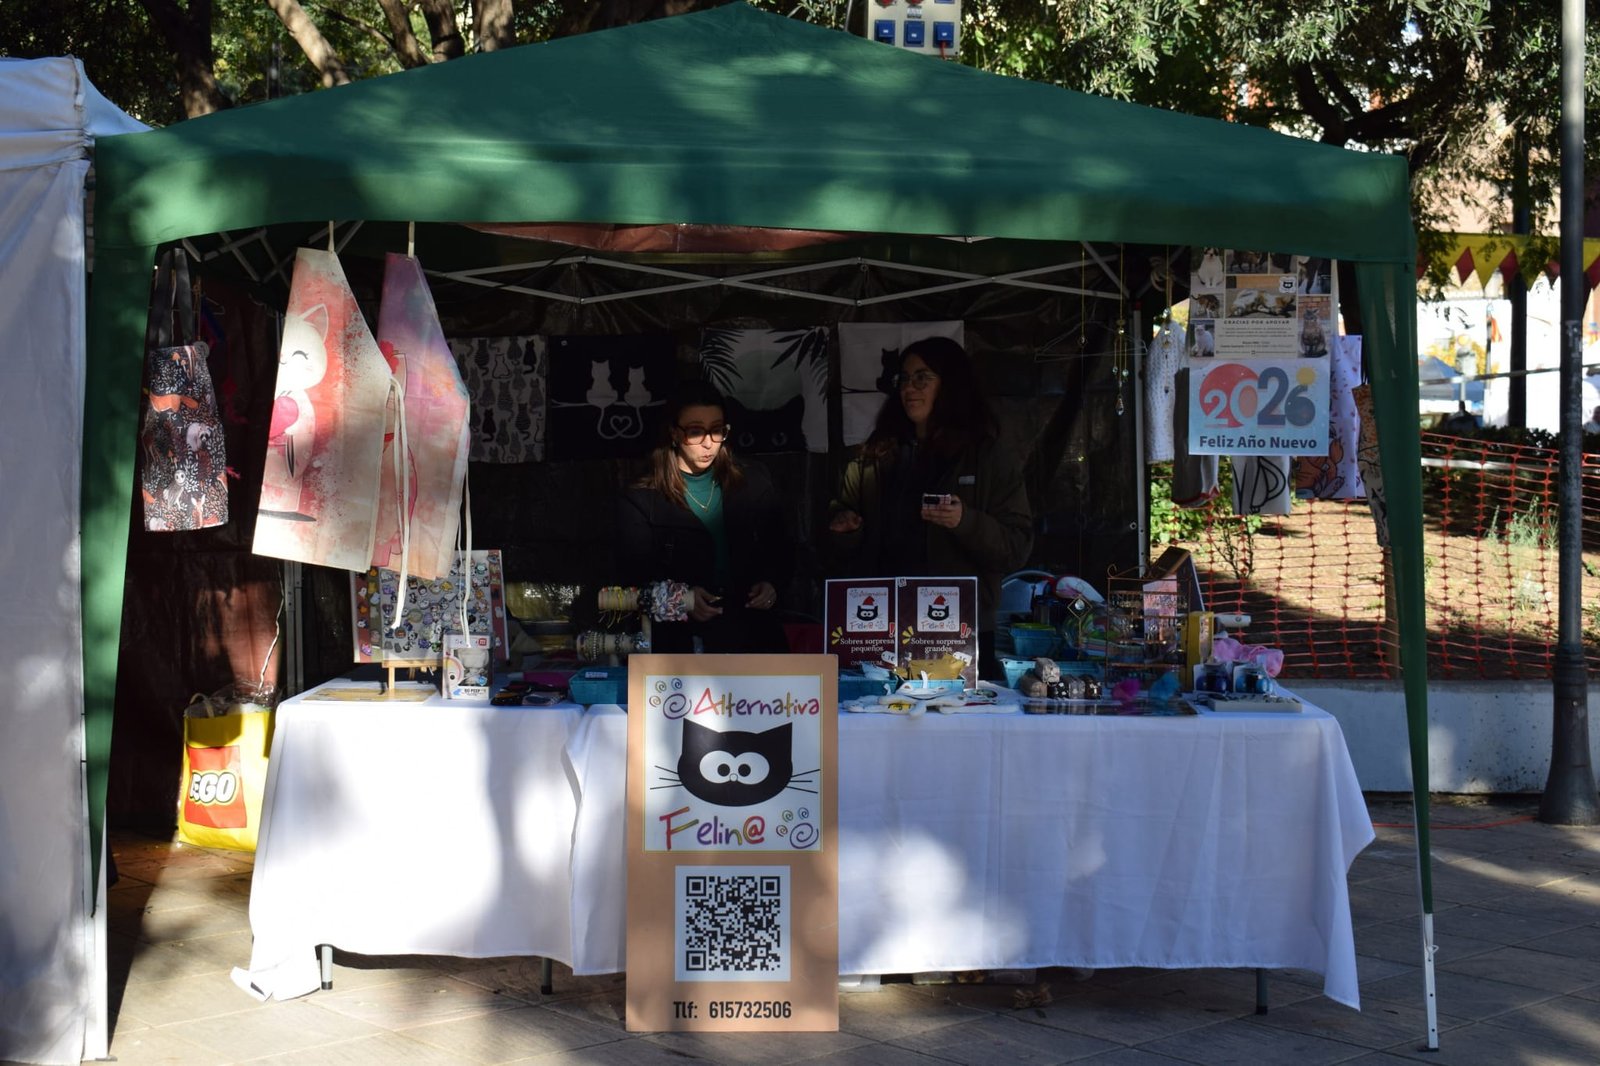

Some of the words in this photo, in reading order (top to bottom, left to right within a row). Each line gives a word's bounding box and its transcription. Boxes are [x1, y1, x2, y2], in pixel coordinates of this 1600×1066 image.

[1203, 366, 1316, 428] 2026
[1199, 435, 1234, 448] Feliz
[1237, 435, 1266, 449] Año
[1270, 436, 1317, 449] Nuevo
[851, 645, 884, 653] pequeños
[865, 638, 895, 646] sorpresa
[936, 638, 966, 646] sorpresa
[925, 646, 953, 654] grandes
[693, 687, 820, 718] Alternativa
[659, 806, 766, 850] Felin@
[673, 1000, 698, 1020] Tlf:
[709, 1000, 792, 1019] 615732506
